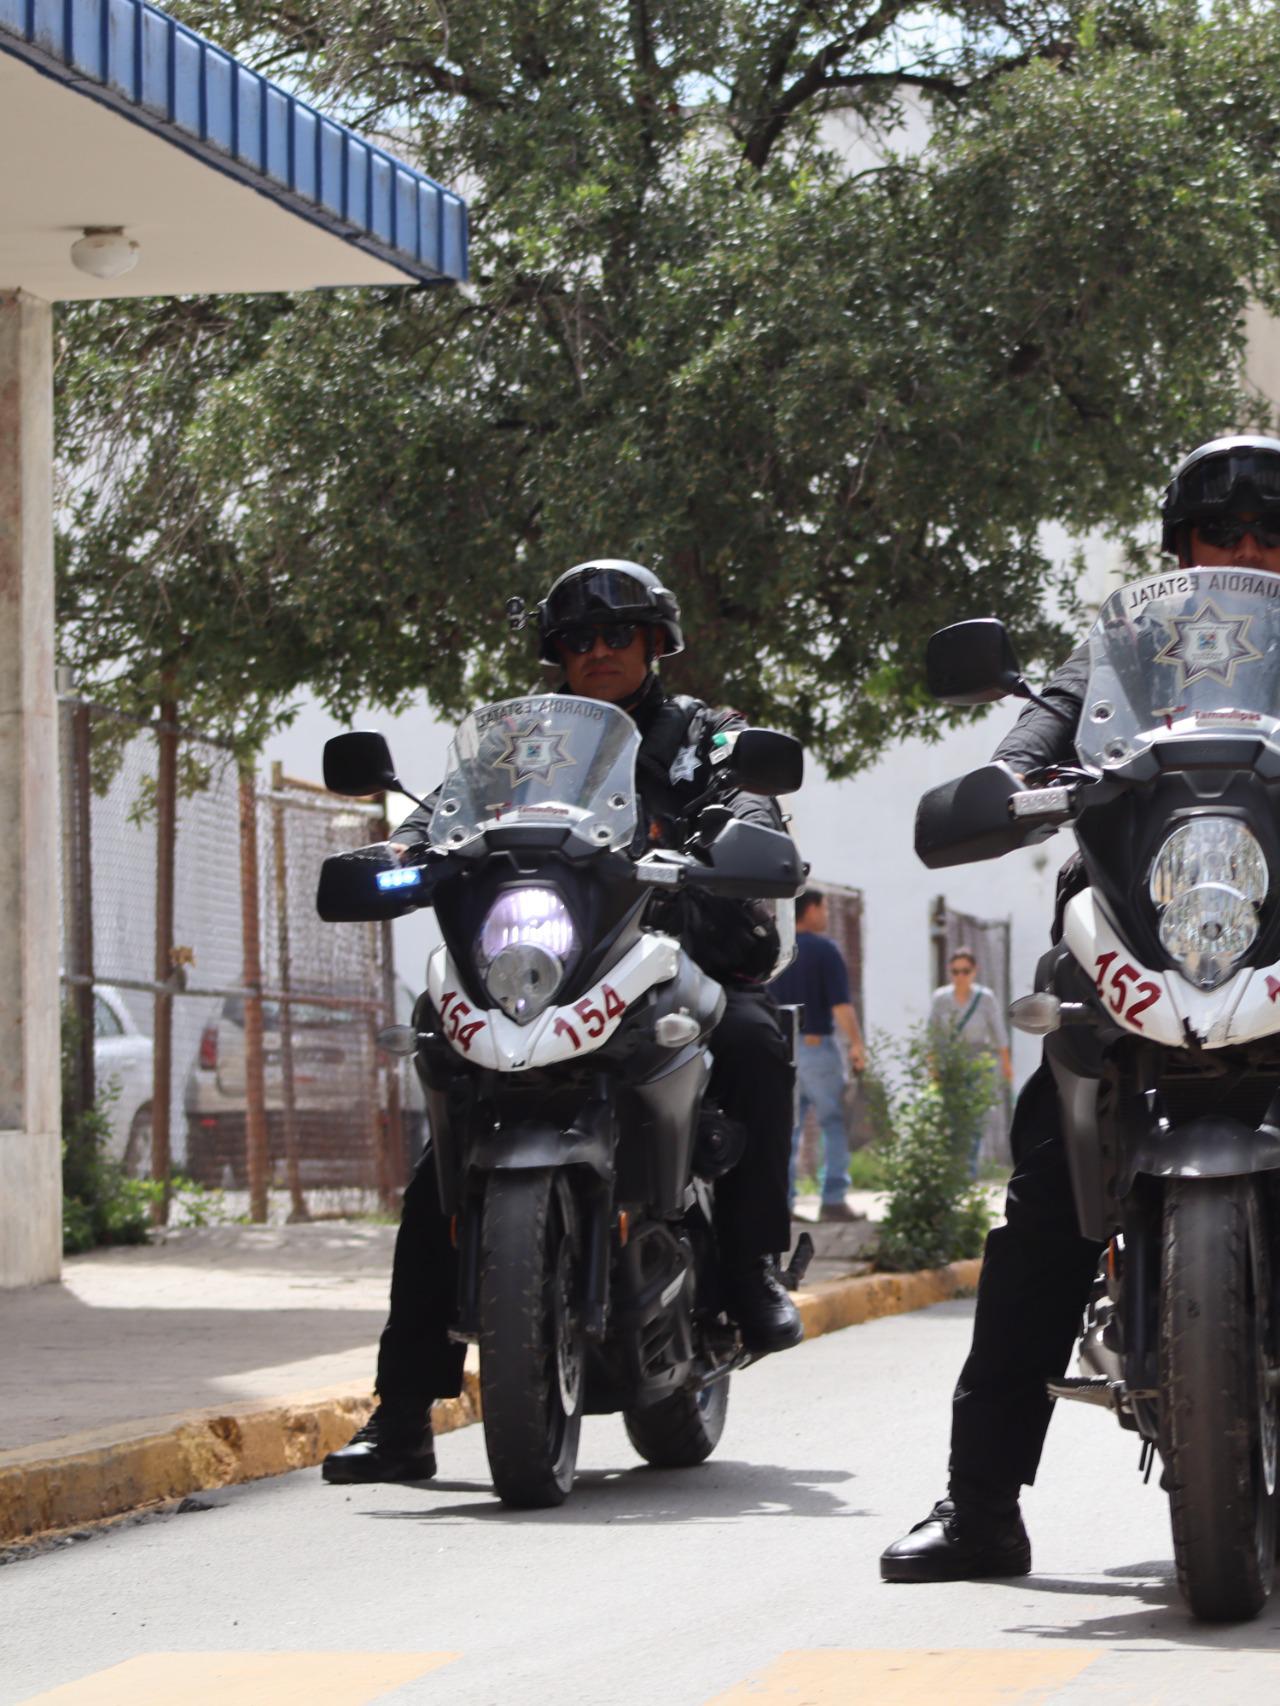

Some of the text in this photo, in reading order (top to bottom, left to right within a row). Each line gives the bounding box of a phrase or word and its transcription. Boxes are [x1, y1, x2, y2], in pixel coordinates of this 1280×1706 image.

[1193, 710, 1262, 722] Tamaulipas
[440, 990, 487, 1053] 154
[553, 983, 627, 1051] 154
[1094, 950, 1162, 1033] 152
